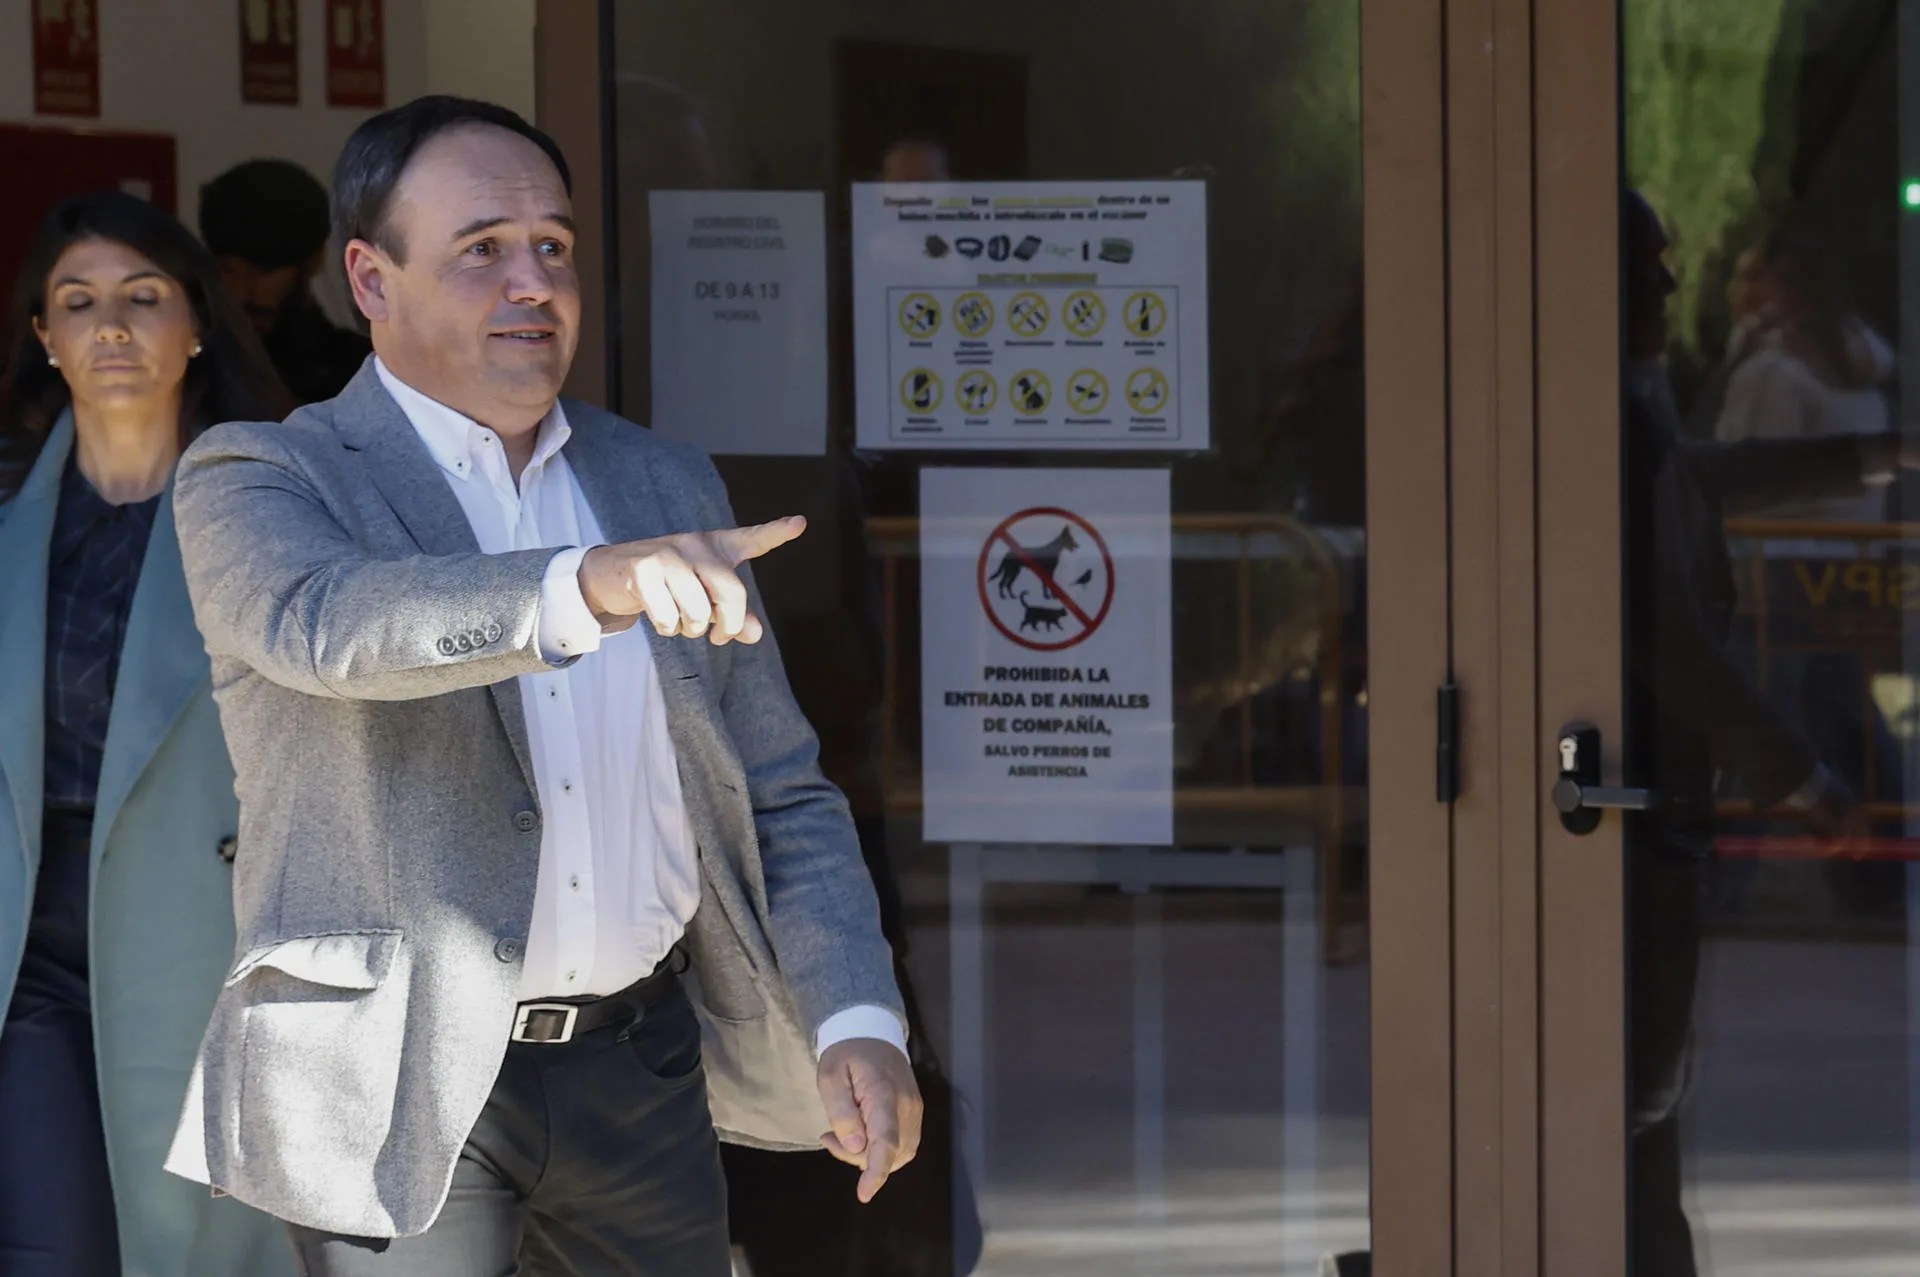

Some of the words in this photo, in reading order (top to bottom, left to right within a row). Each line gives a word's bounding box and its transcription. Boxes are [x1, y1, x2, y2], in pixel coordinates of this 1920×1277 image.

[695, 281, 721, 299] DE
[741, 281, 755, 299] A
[760, 282, 780, 299] 13
[984, 666, 1082, 682] PROHIBIDA
[1088, 668, 1110, 682] LA
[944, 691, 1026, 707] ENTRADA
[1031, 692, 1055, 708] DE
[1059, 692, 1150, 709] ANIMALES
[983, 717, 1008, 733] DE
[1012, 714, 1112, 736] COMPAÑÍA,
[984, 744, 1029, 758] SALVO
[1032, 745, 1089, 758] PERROS
[1092, 746, 1112, 758] DE
[1008, 764, 1088, 778] ASISTENCIA
